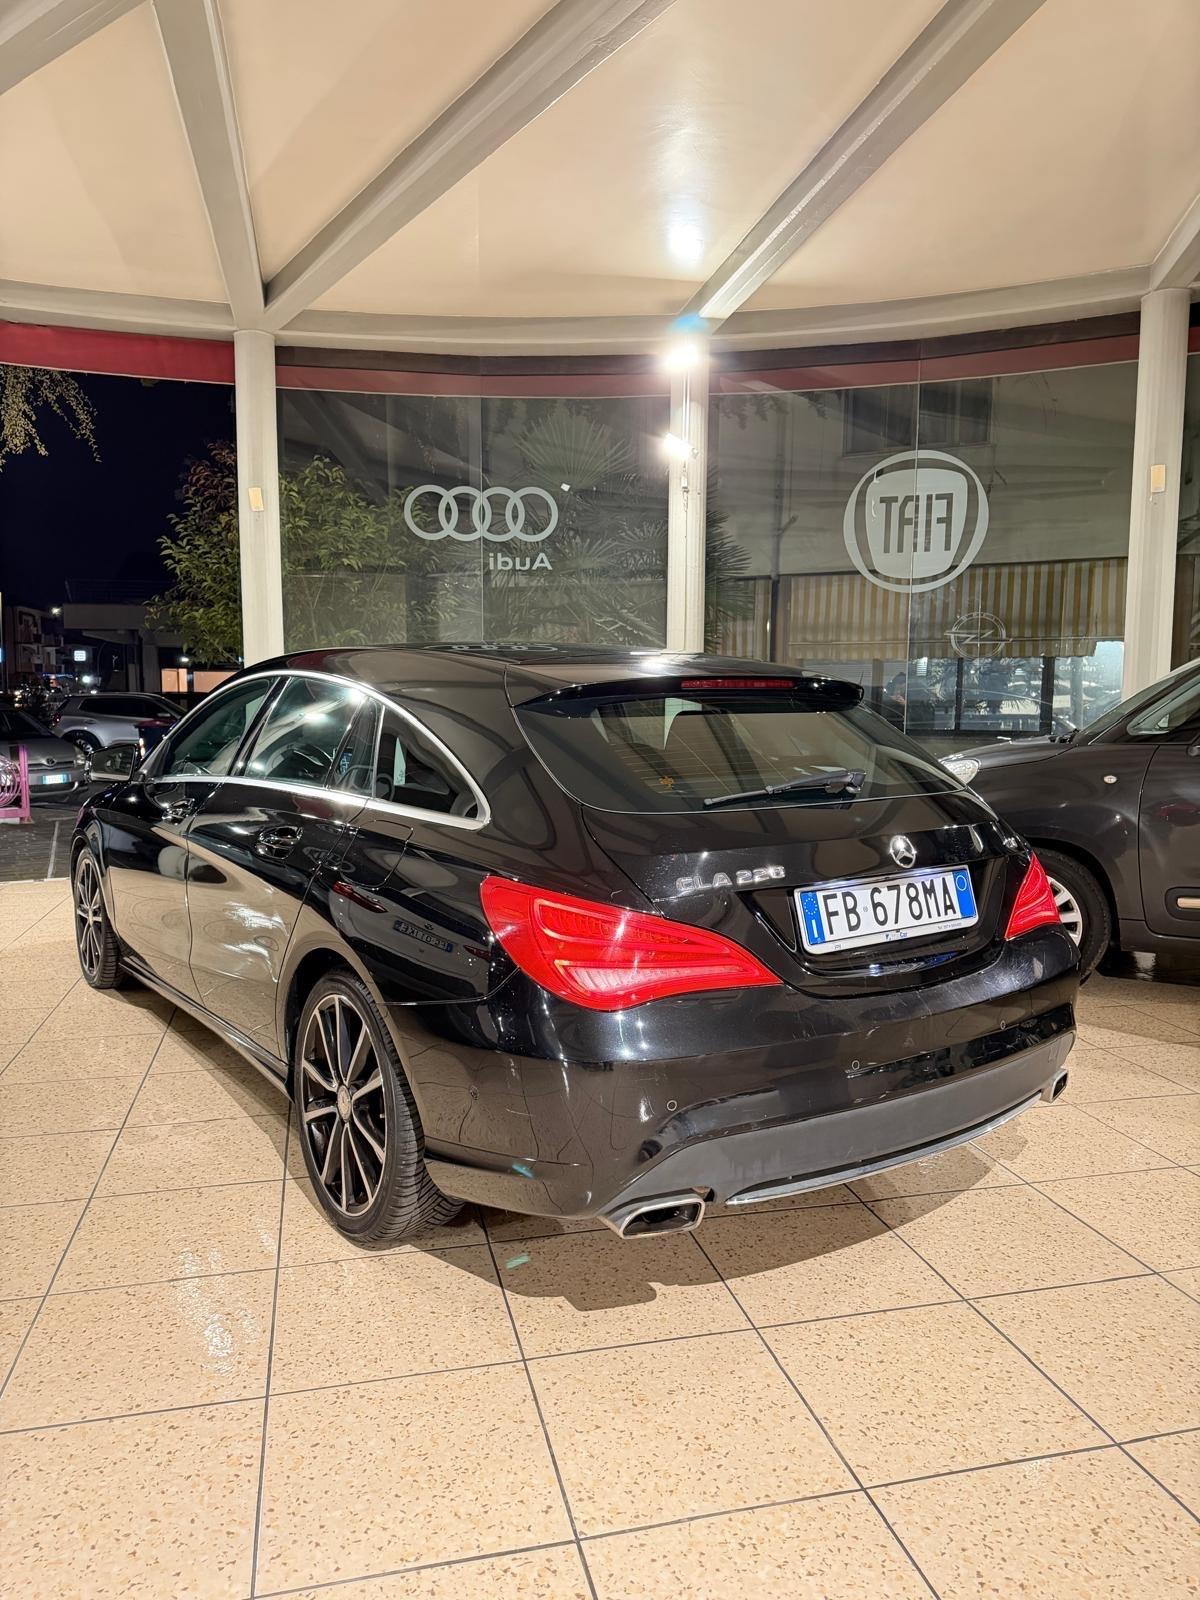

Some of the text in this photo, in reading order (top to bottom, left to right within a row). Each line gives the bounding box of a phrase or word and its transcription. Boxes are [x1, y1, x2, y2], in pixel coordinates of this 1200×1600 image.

[675, 872, 733, 892] CLA
[822, 876, 958, 935] FB 678MA
